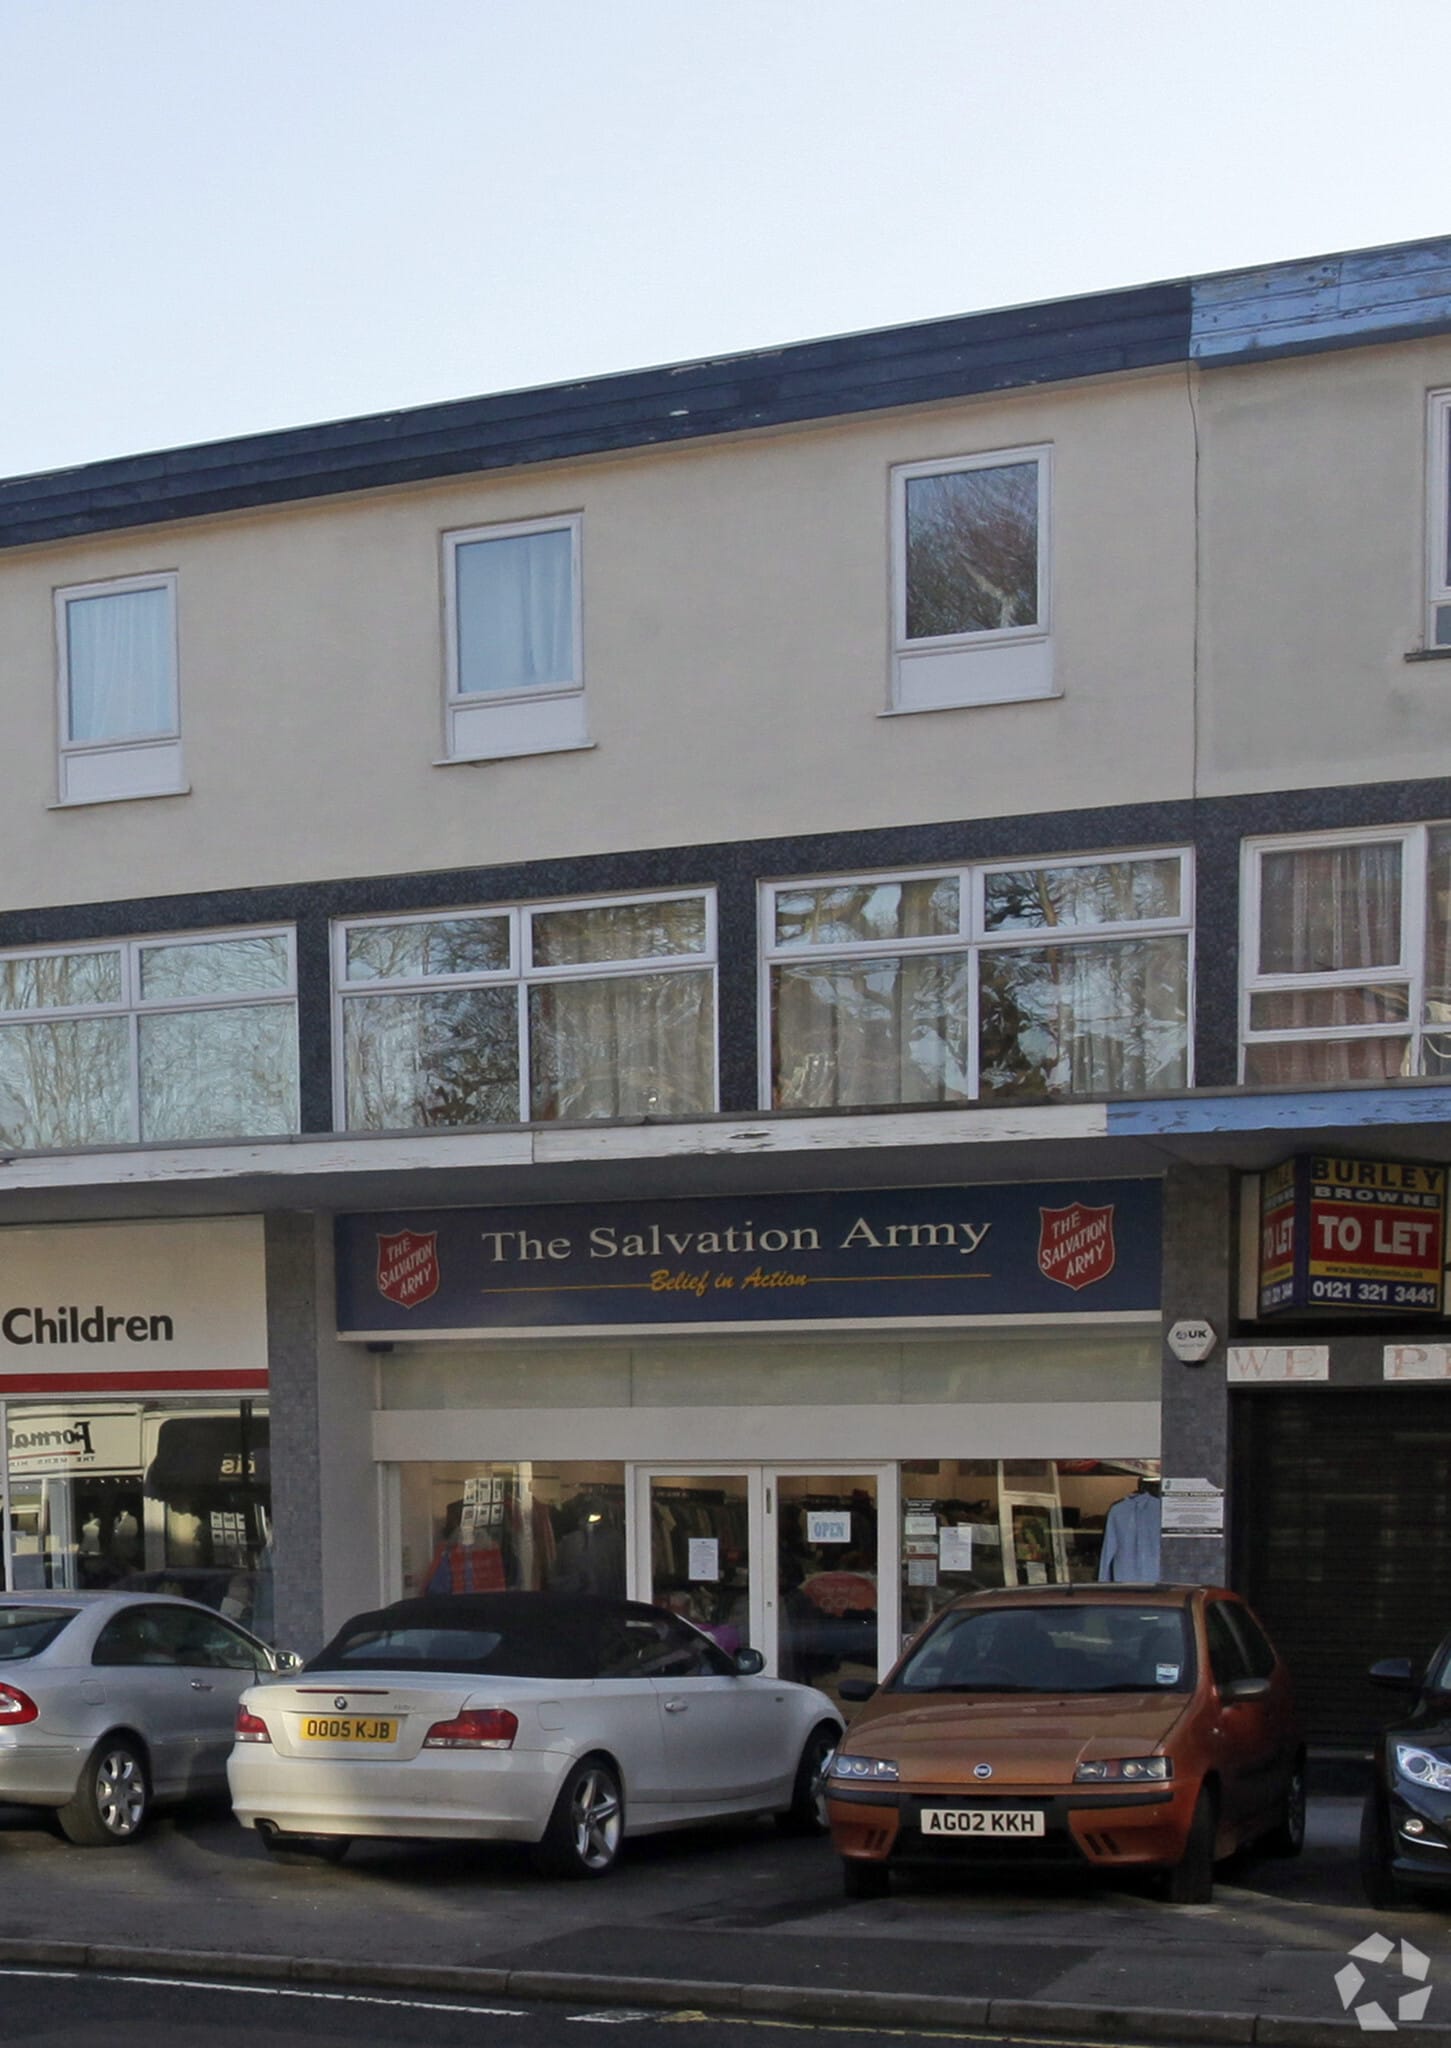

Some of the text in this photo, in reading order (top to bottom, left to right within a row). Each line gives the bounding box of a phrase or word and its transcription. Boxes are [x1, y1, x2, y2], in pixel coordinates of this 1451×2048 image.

[1311, 1159, 1441, 1190] BURLEY
[1313, 1185, 1439, 1208] BROWNE
[481, 1217, 992, 1263] The Salvation Army
[1051, 1210, 1081, 1240] THE
[1317, 1214, 1433, 1256] TO LET
[386, 1237, 411, 1263] THE
[1041, 1214, 1107, 1270] SALVATION
[380, 1240, 433, 1291] SALVATION
[1065, 1240, 1105, 1280] ARMY
[400, 1263, 432, 1299] ARMY
[650, 1266, 808, 1297] Belief in Action
[1312, 1280, 1352, 1299] 0121
[1357, 1284, 1388, 1301] 321
[1394, 1286, 1435, 1304] 3441
[2, 1305, 174, 1345] Children
[1188, 1330, 1207, 1339] UK
[813, 1521, 845, 1537] OPEN
[355, 1721, 390, 1739] KJB
[991, 1813, 1035, 1832] KKH
